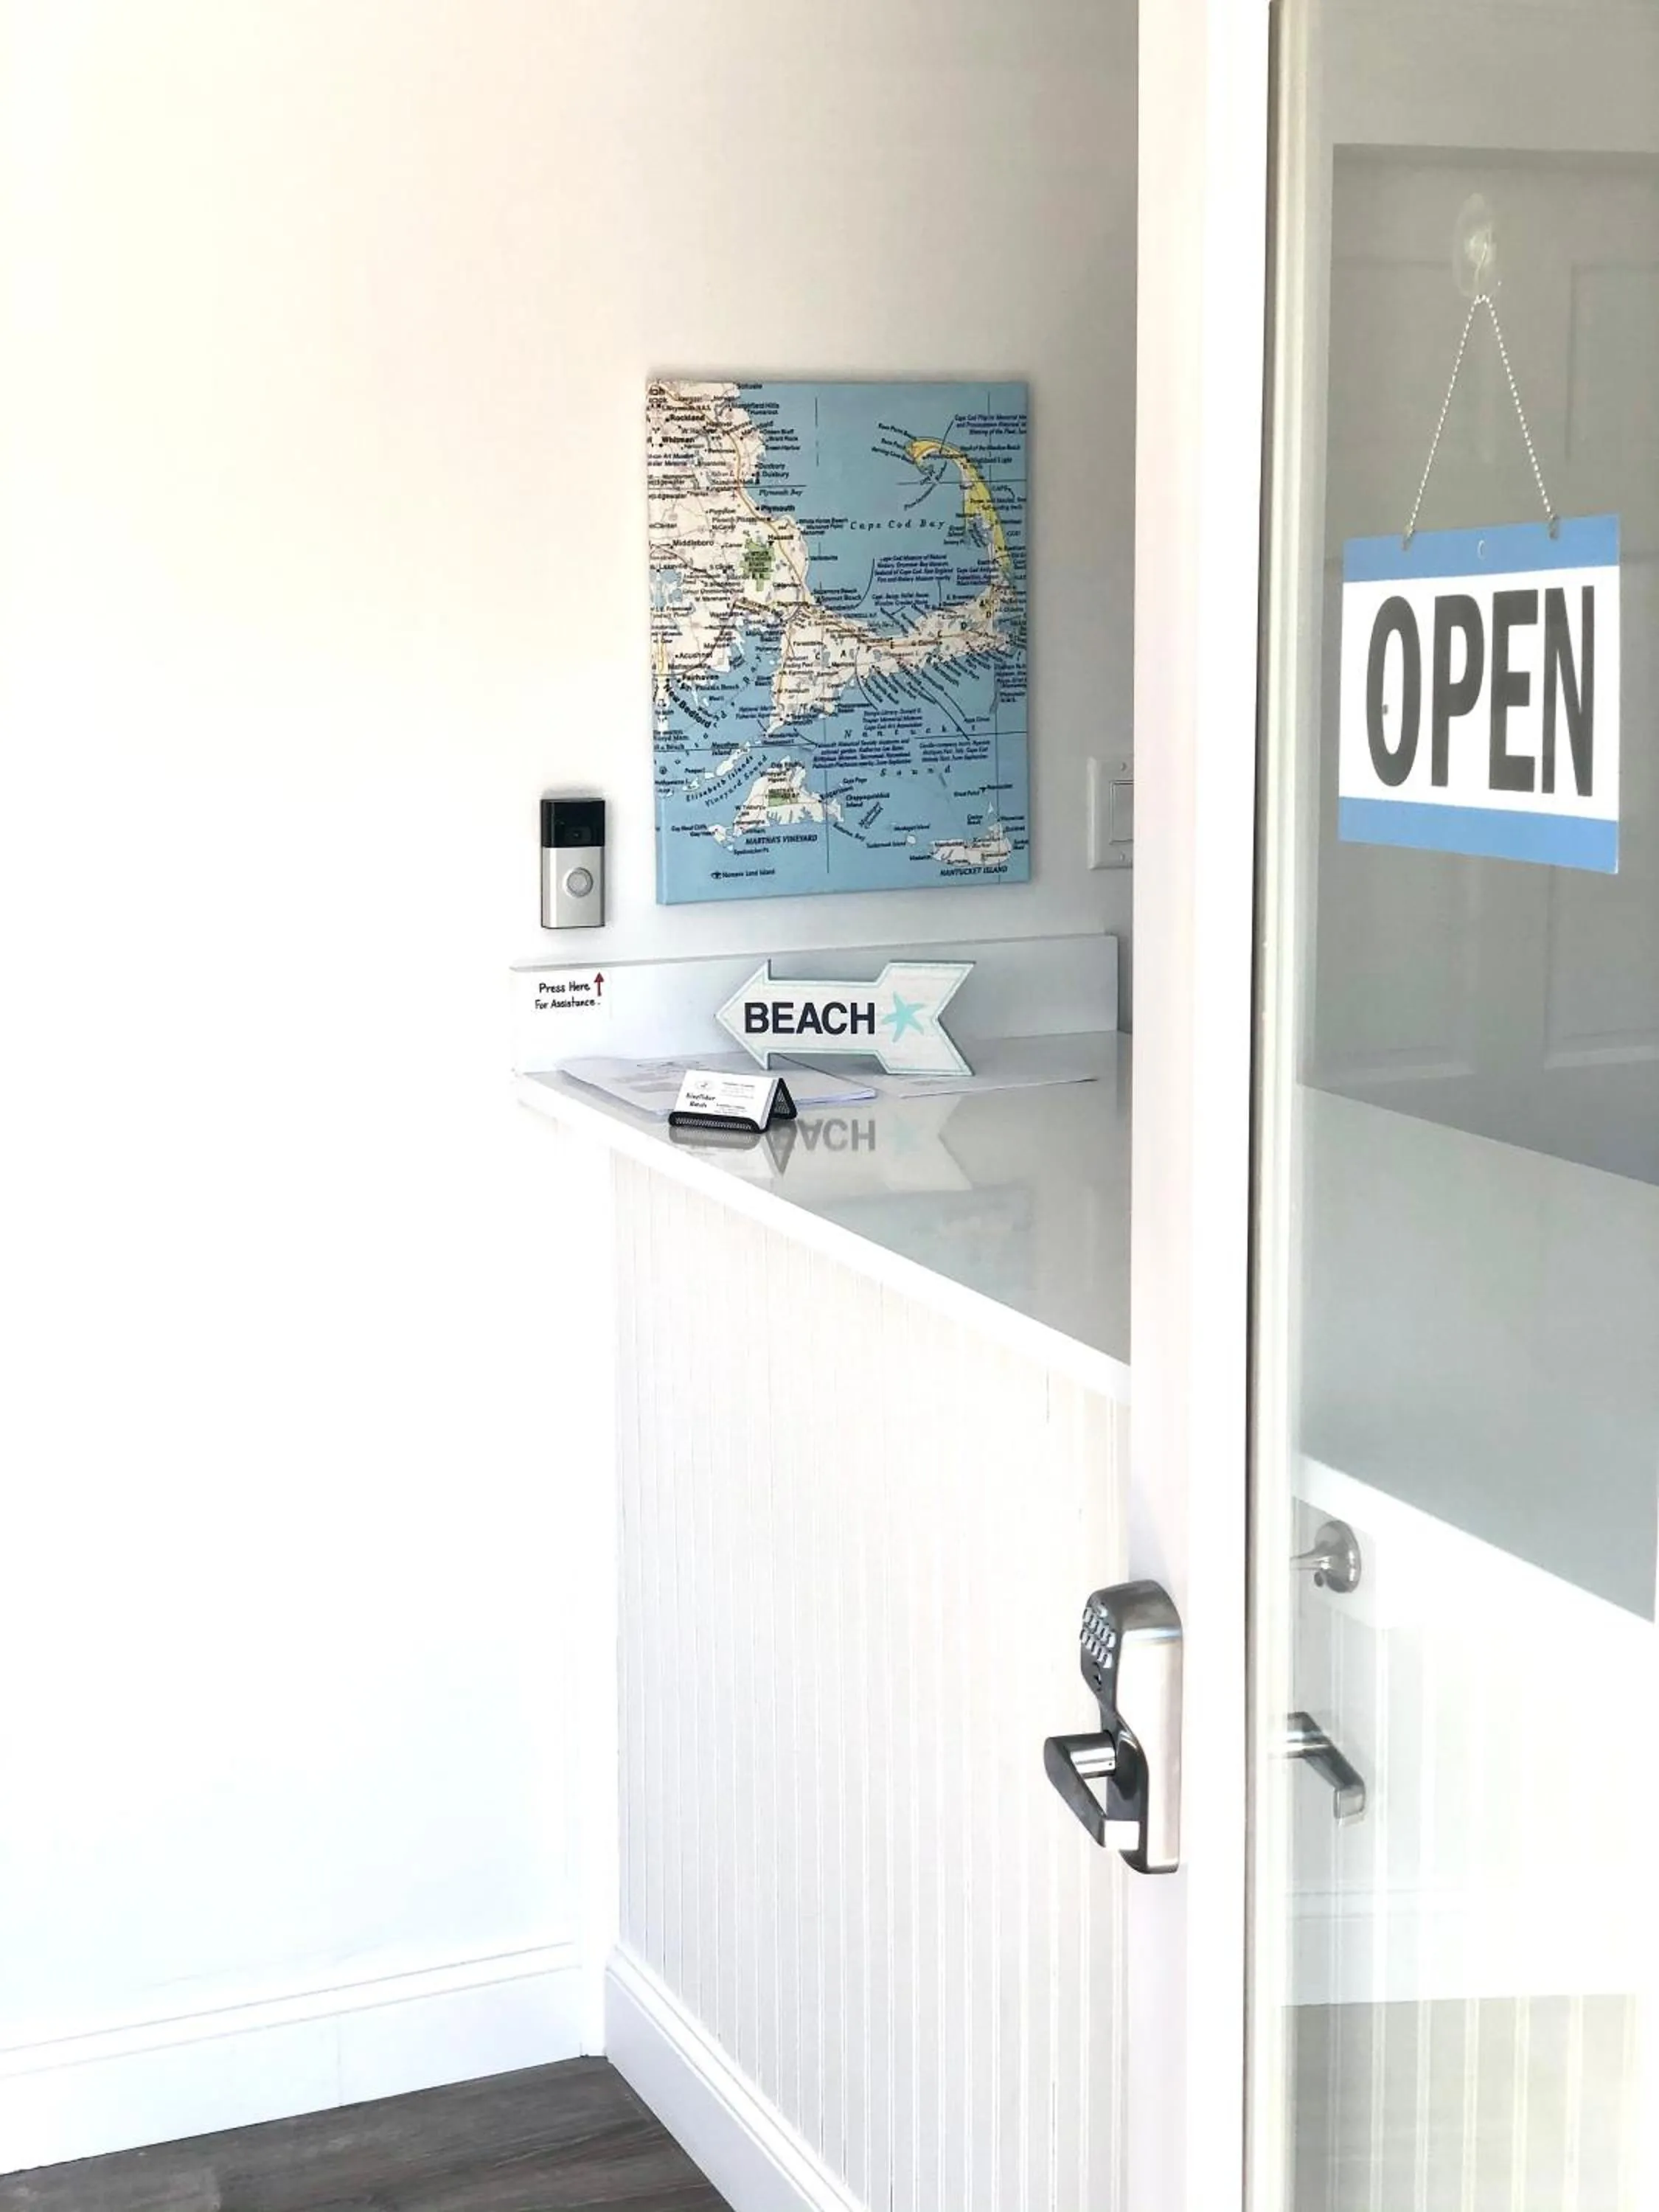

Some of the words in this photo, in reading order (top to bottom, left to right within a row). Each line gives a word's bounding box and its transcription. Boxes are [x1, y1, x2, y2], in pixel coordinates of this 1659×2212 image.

[888, 519, 912, 529] Cod
[1366, 585, 1594, 796] OPEN
[539, 982, 566, 993] Press
[568, 980, 591, 992] Here
[535, 999, 549, 1009] For
[744, 1002, 875, 1034] BEACH
